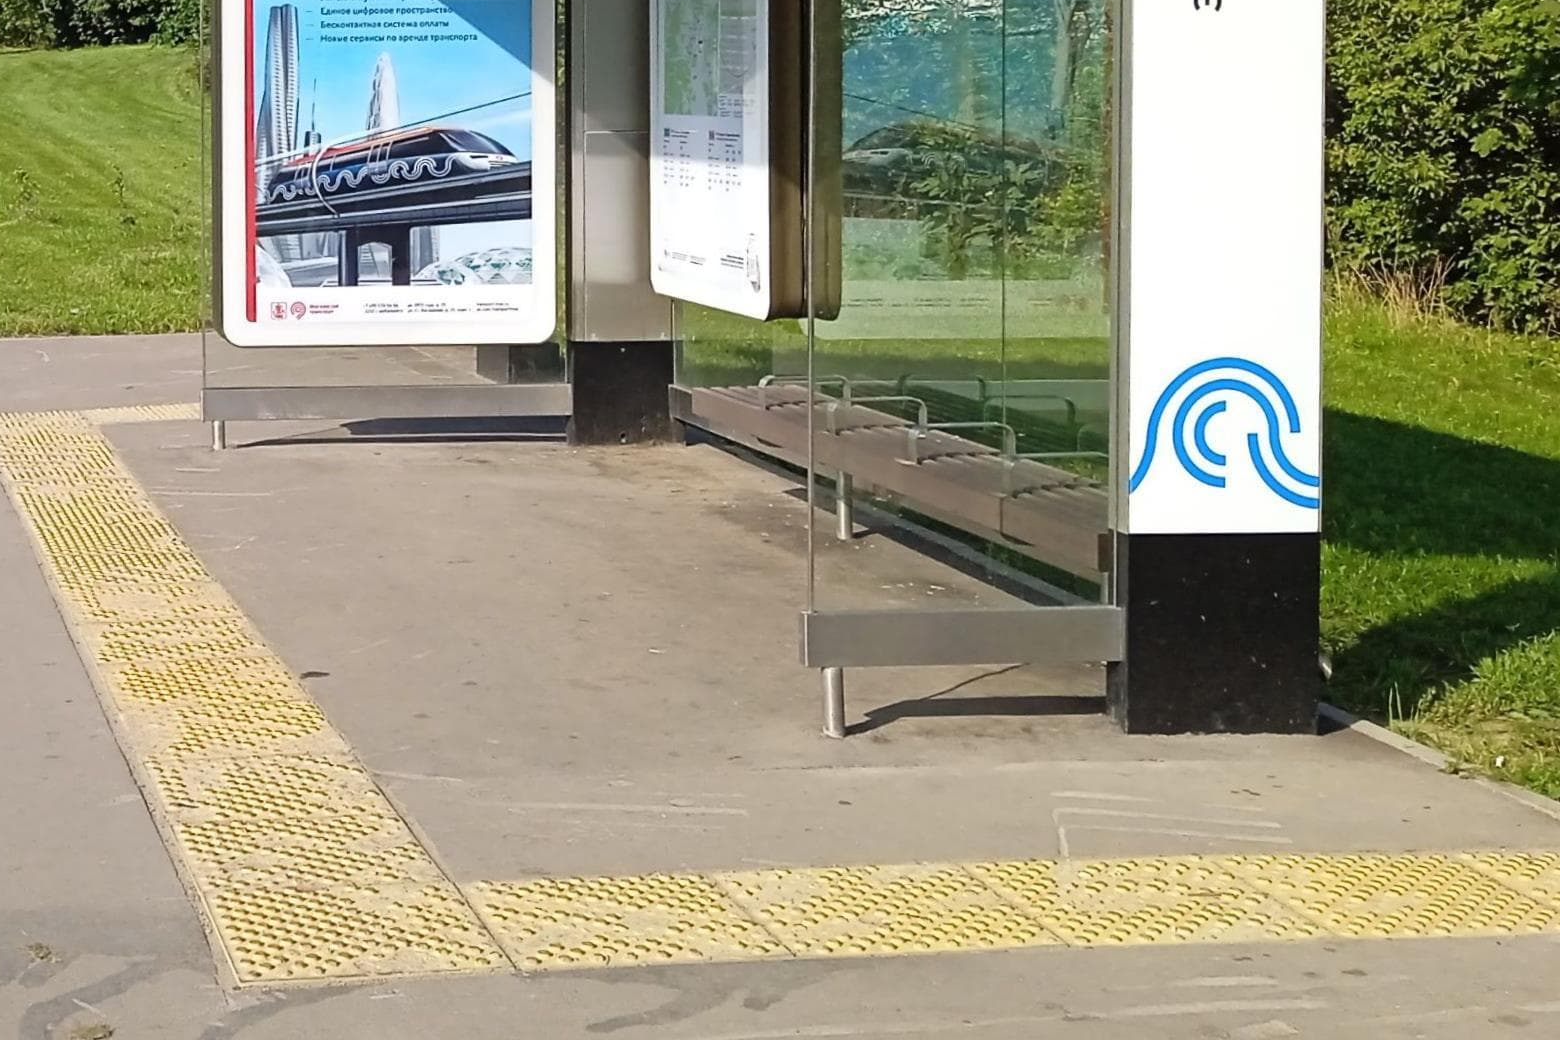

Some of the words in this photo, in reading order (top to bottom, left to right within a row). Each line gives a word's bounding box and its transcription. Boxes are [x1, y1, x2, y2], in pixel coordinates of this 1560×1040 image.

[320, 7, 352, 16] Единое
[352, 6, 395, 17] цифровое
[396, 6, 454, 15] пространство
[320, 20, 382, 29] Бесконтактная
[383, 20, 418, 28] система
[419, 20, 450, 28] оплаты
[320, 35, 348, 43] Новые
[349, 34, 385, 43] сервисы
[398, 33, 429, 43] аренде
[430, 33, 478, 42] транспорта
